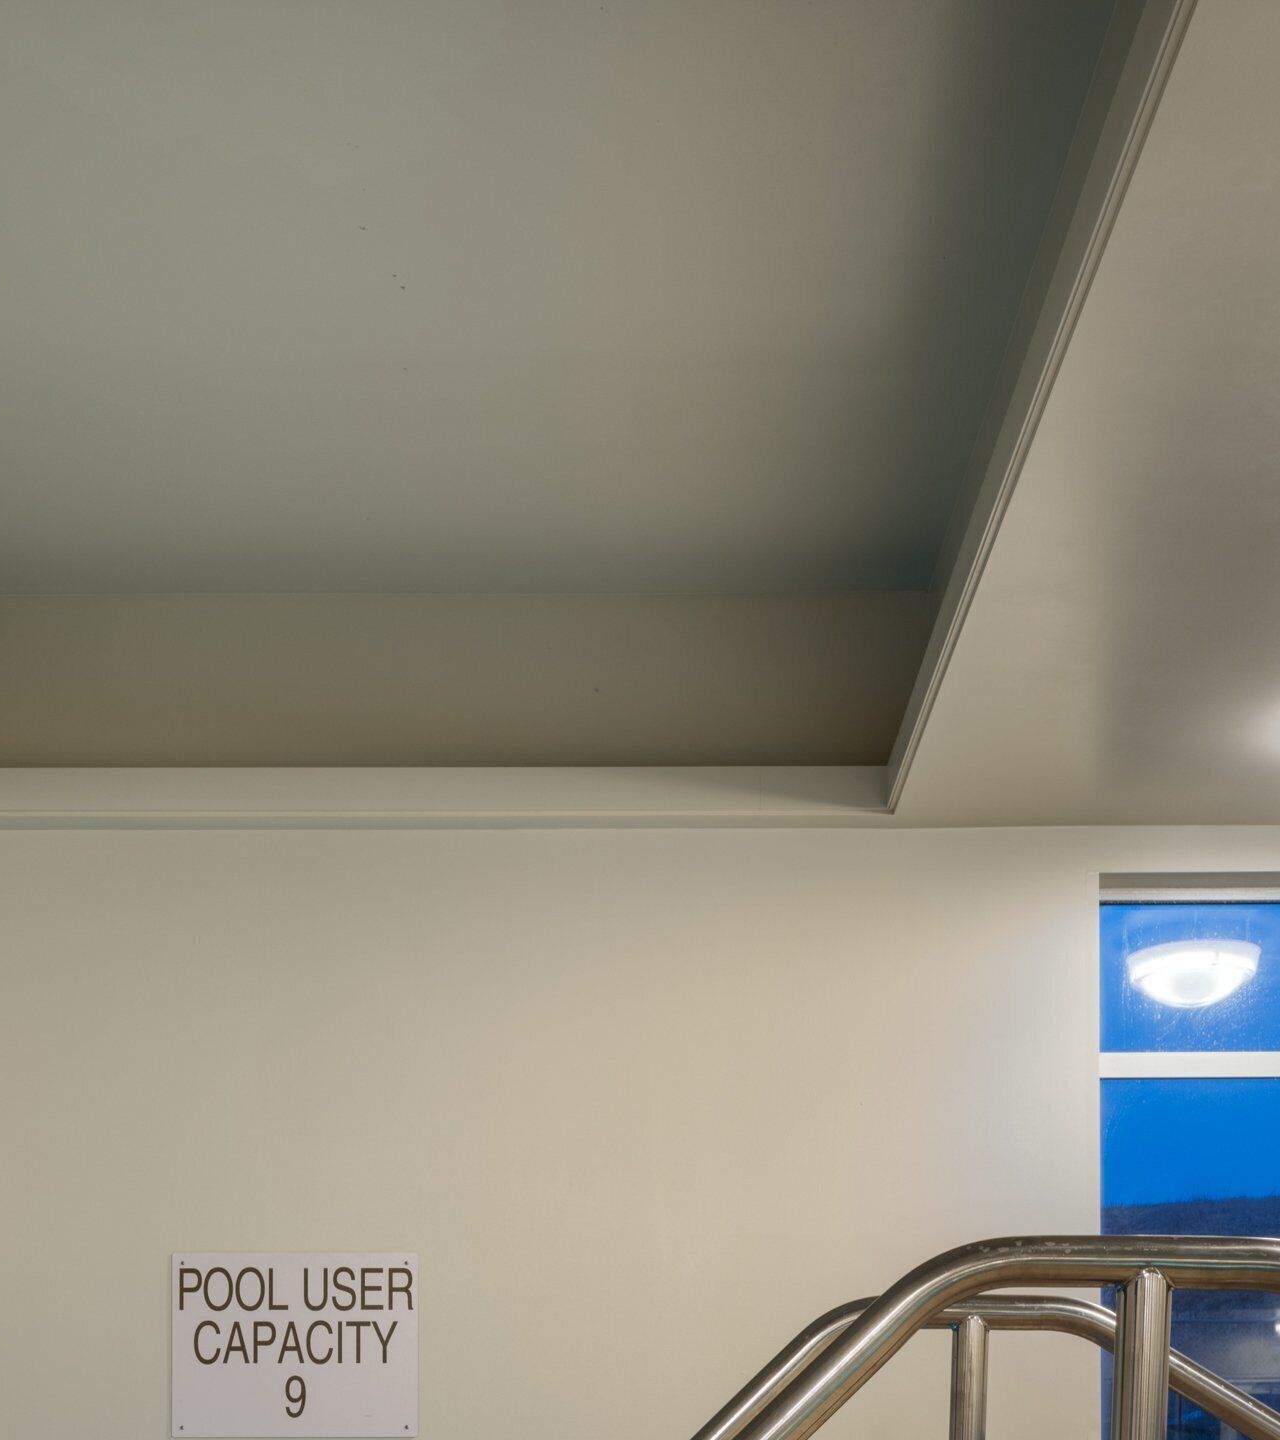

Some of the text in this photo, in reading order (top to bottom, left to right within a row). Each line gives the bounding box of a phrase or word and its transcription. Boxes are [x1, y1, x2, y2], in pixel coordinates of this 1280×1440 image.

[179, 1266, 413, 1311] POOL USER
[193, 1320, 398, 1365] CAPACITY
[285, 1375, 307, 1418] 9
